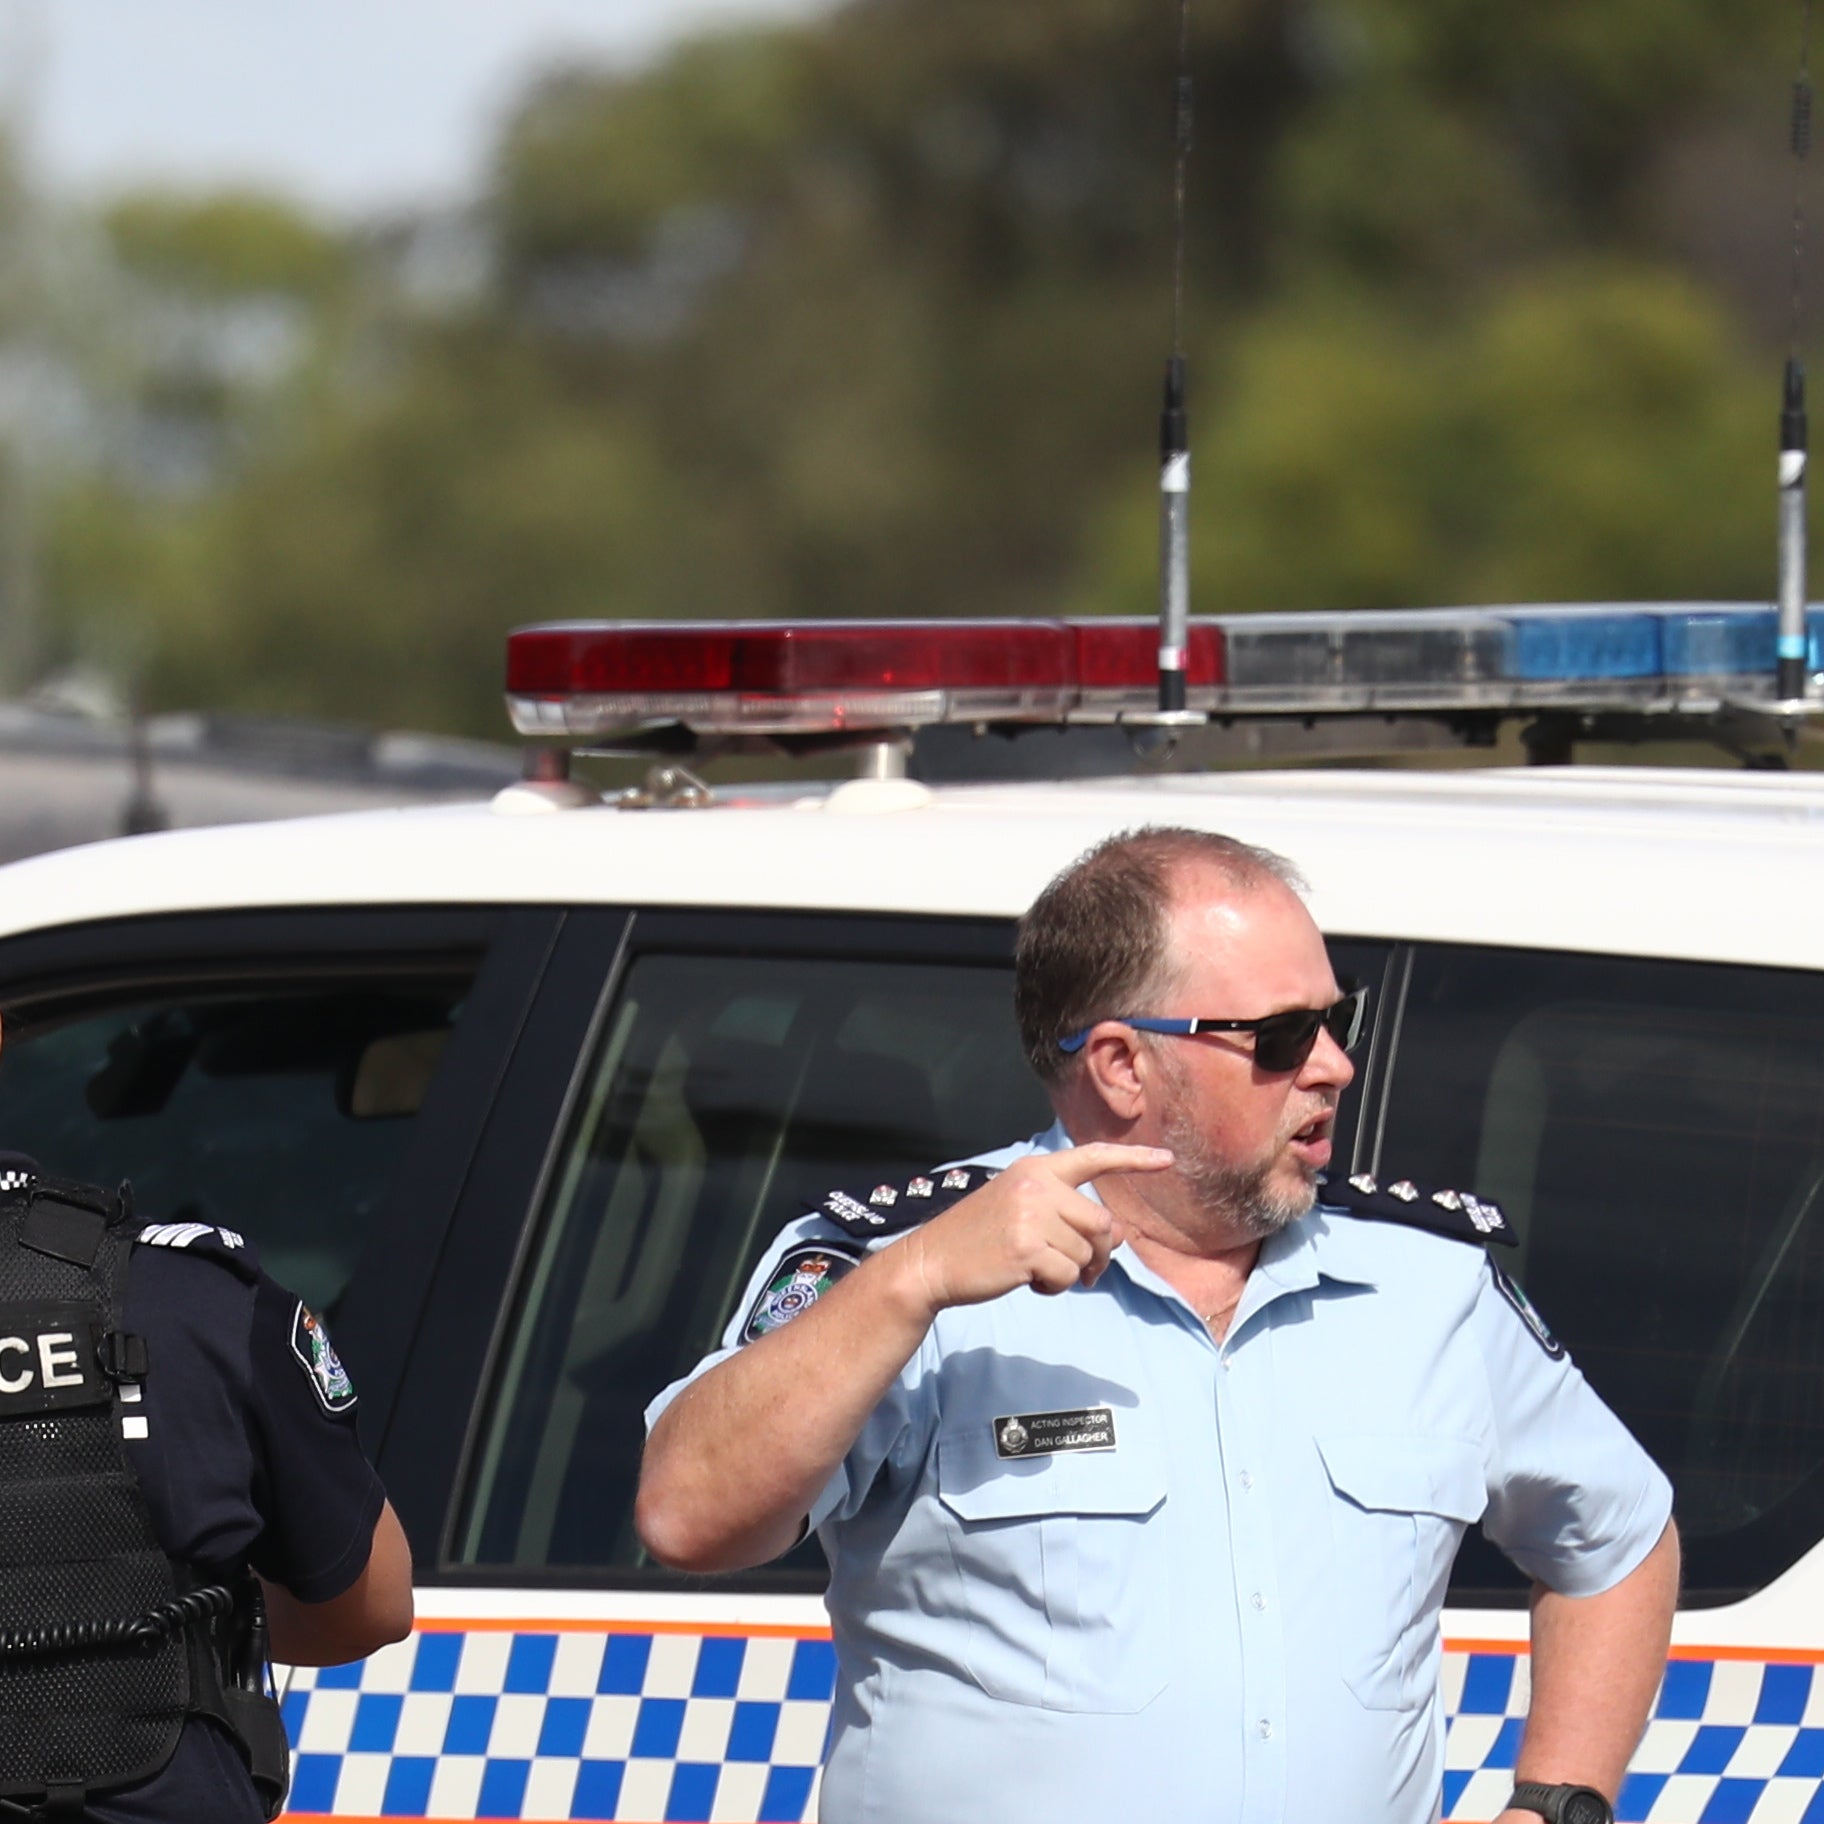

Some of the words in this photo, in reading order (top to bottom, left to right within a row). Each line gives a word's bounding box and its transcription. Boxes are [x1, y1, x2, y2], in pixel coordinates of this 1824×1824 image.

[1031, 1417, 1060, 1429] ACTING
[1062, 1414, 1108, 1427] INSPECTOR
[1034, 1437, 1053, 1448] DAN
[1055, 1431, 1108, 1445] GALLAGHER
